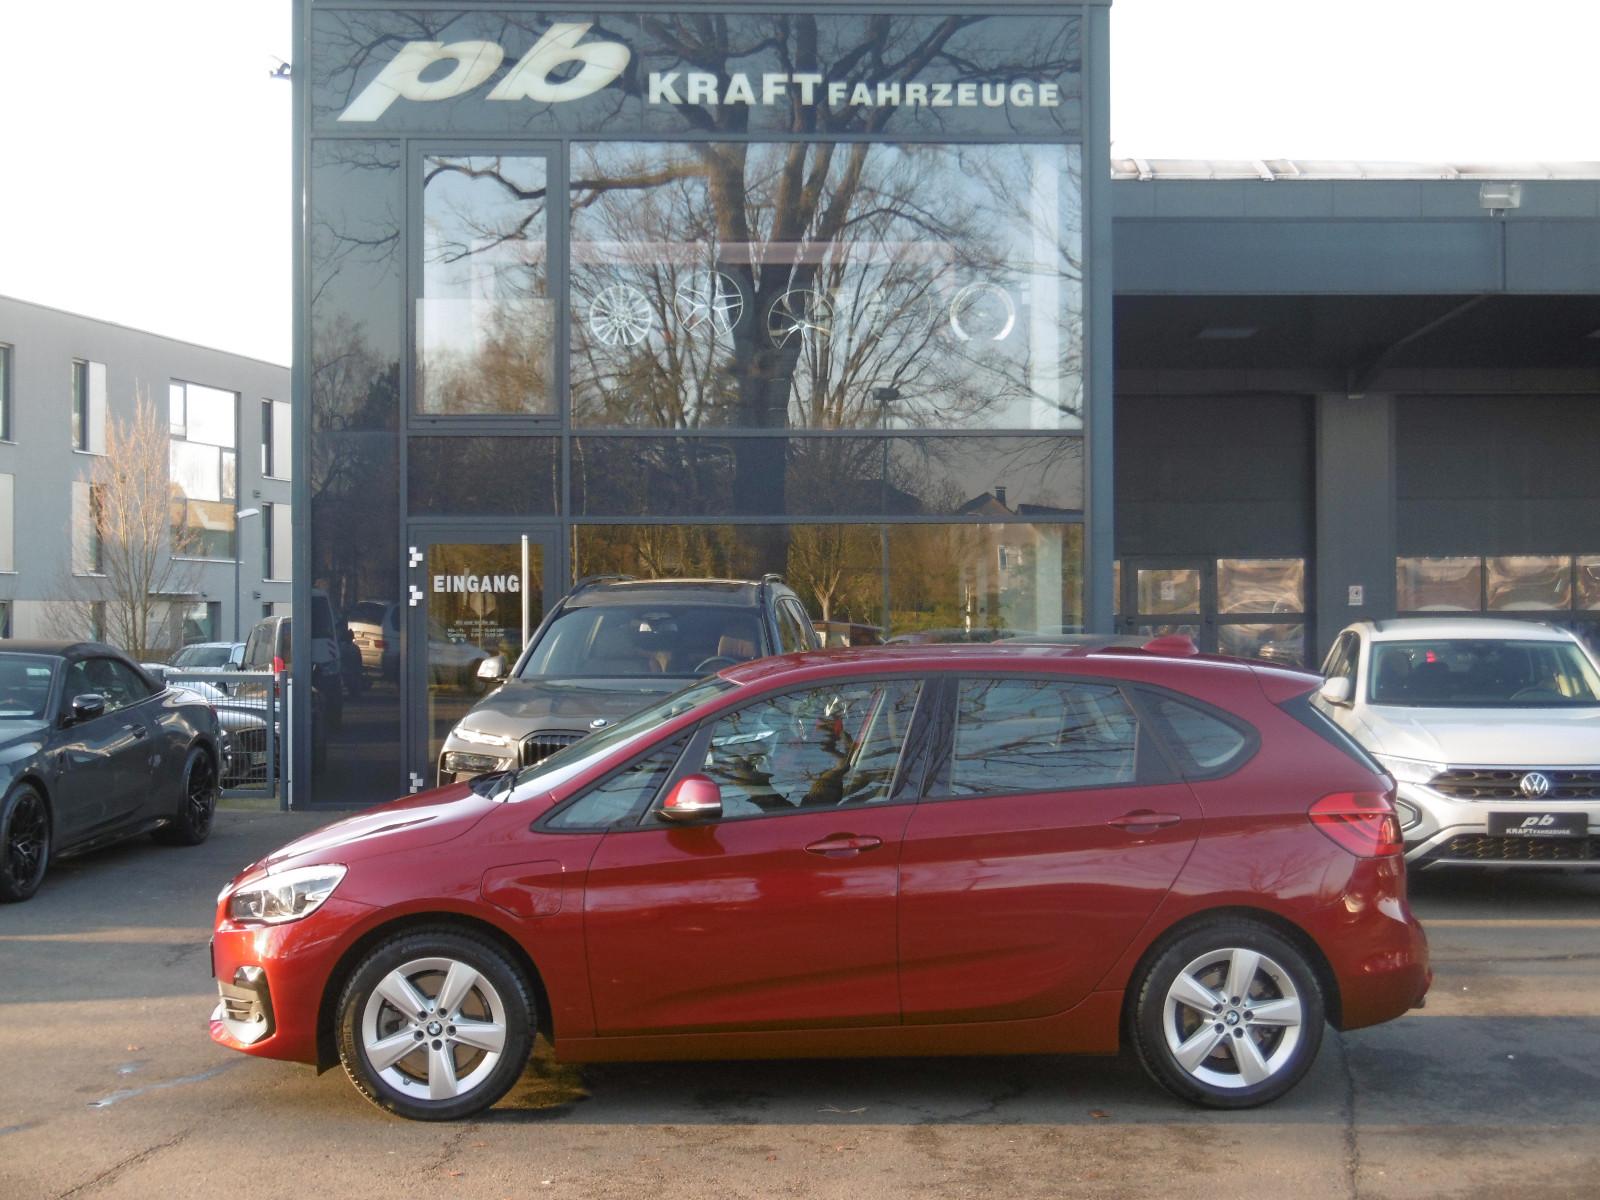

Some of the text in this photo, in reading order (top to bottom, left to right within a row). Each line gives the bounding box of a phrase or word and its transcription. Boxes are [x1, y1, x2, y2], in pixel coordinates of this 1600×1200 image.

[337, 23, 1061, 122] pb KRAFTFAHRZEUGE
[433, 574, 521, 593] EINGANG
[1520, 814, 1555, 827] pb
